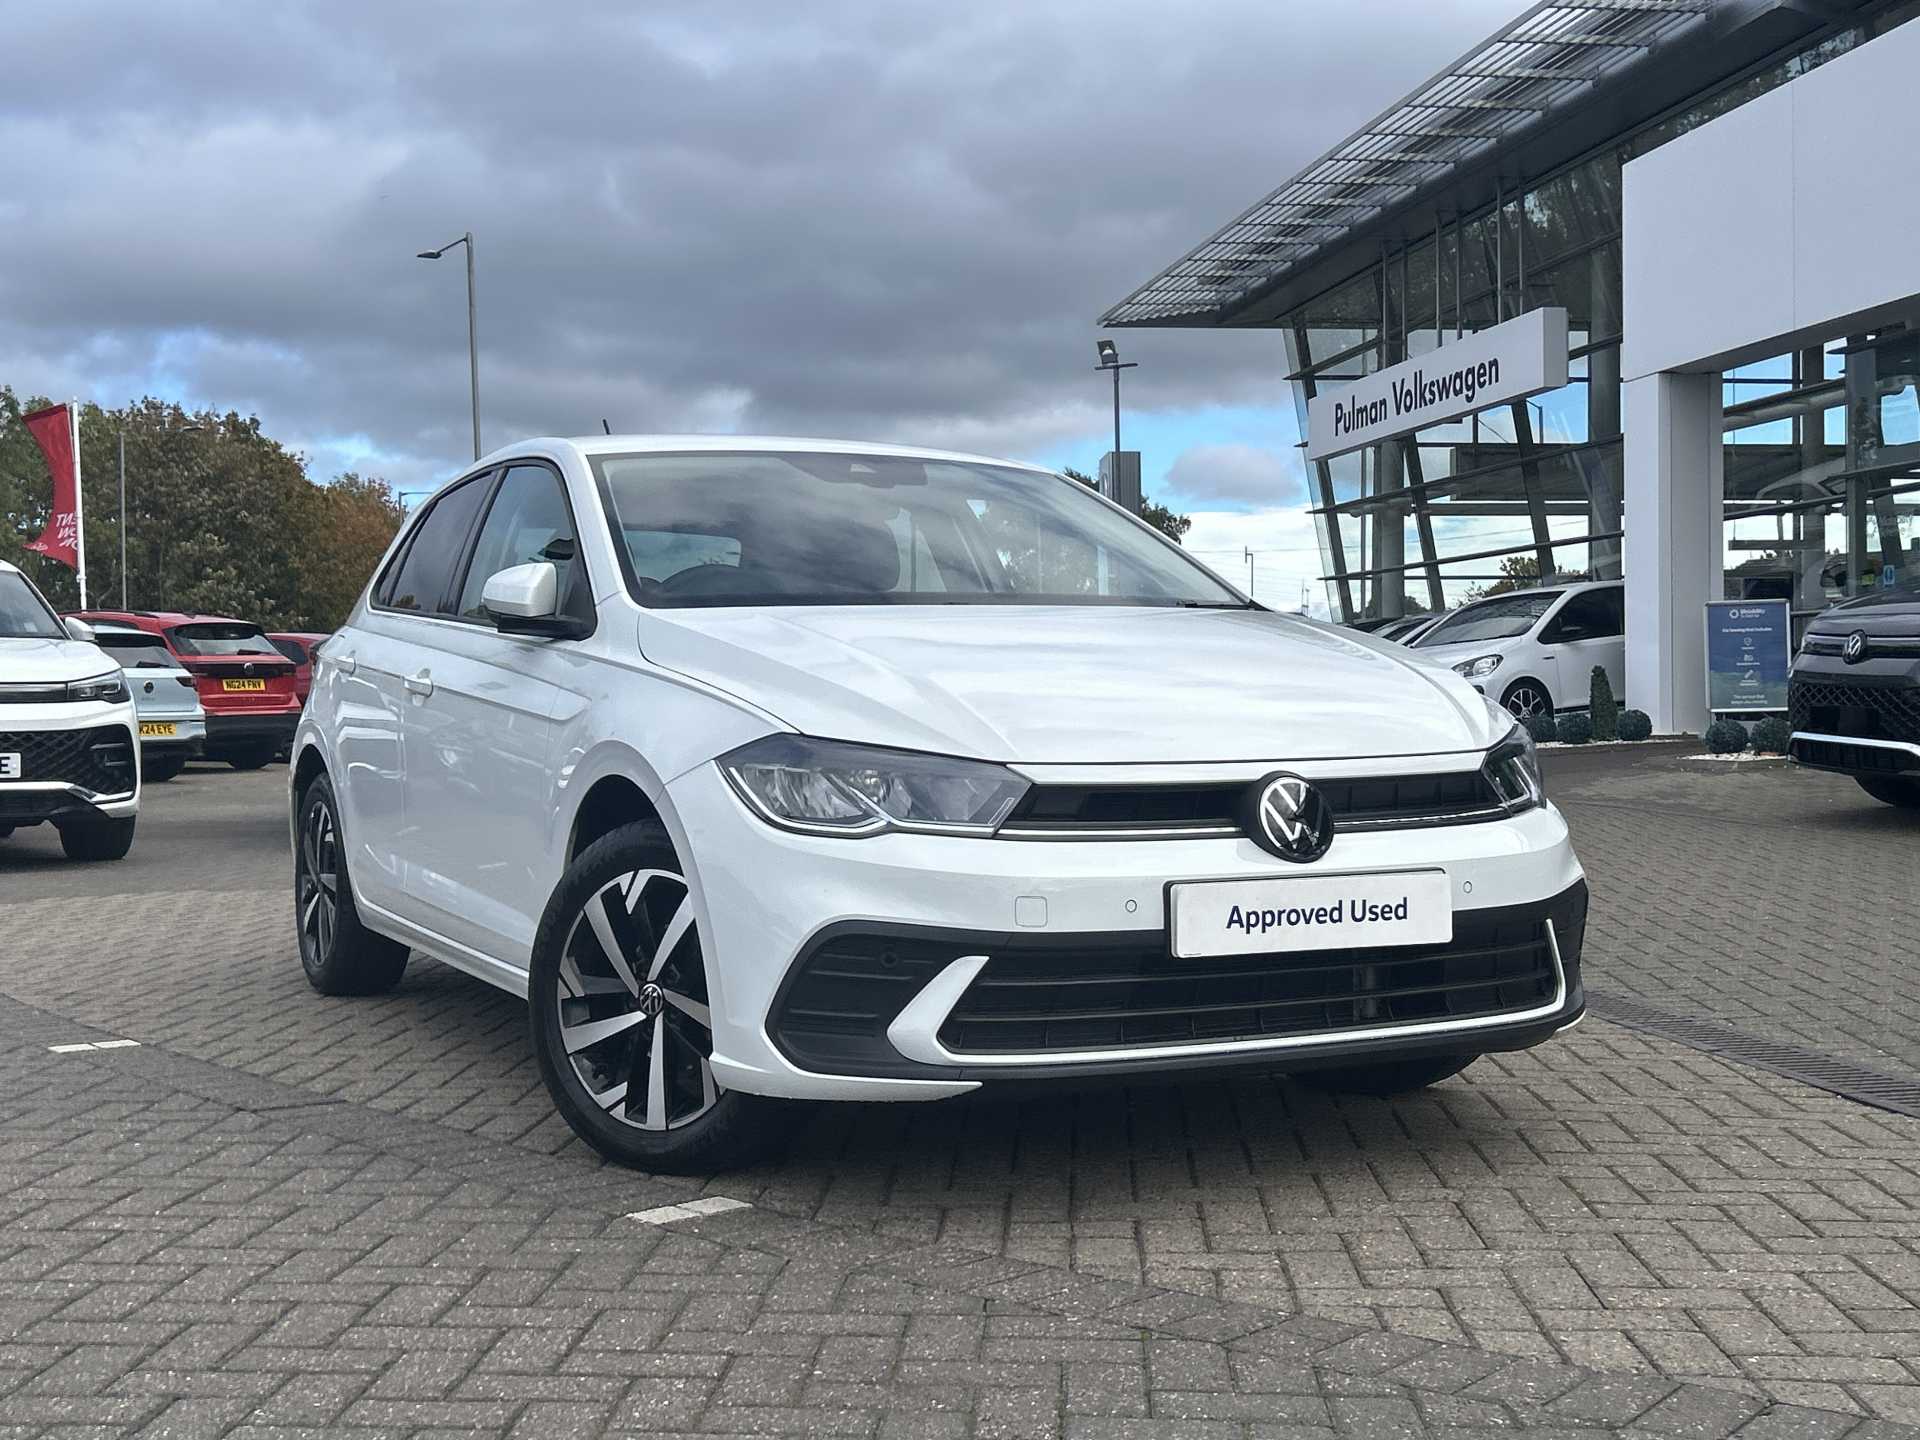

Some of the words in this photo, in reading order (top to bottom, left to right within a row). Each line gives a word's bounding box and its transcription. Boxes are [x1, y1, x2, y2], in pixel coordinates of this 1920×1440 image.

[1335, 395, 1387, 436] Pulman
[1392, 358, 1499, 416] Volkswagen
[1226, 900, 1343, 934] Approved
[1350, 897, 1408, 922] Used
